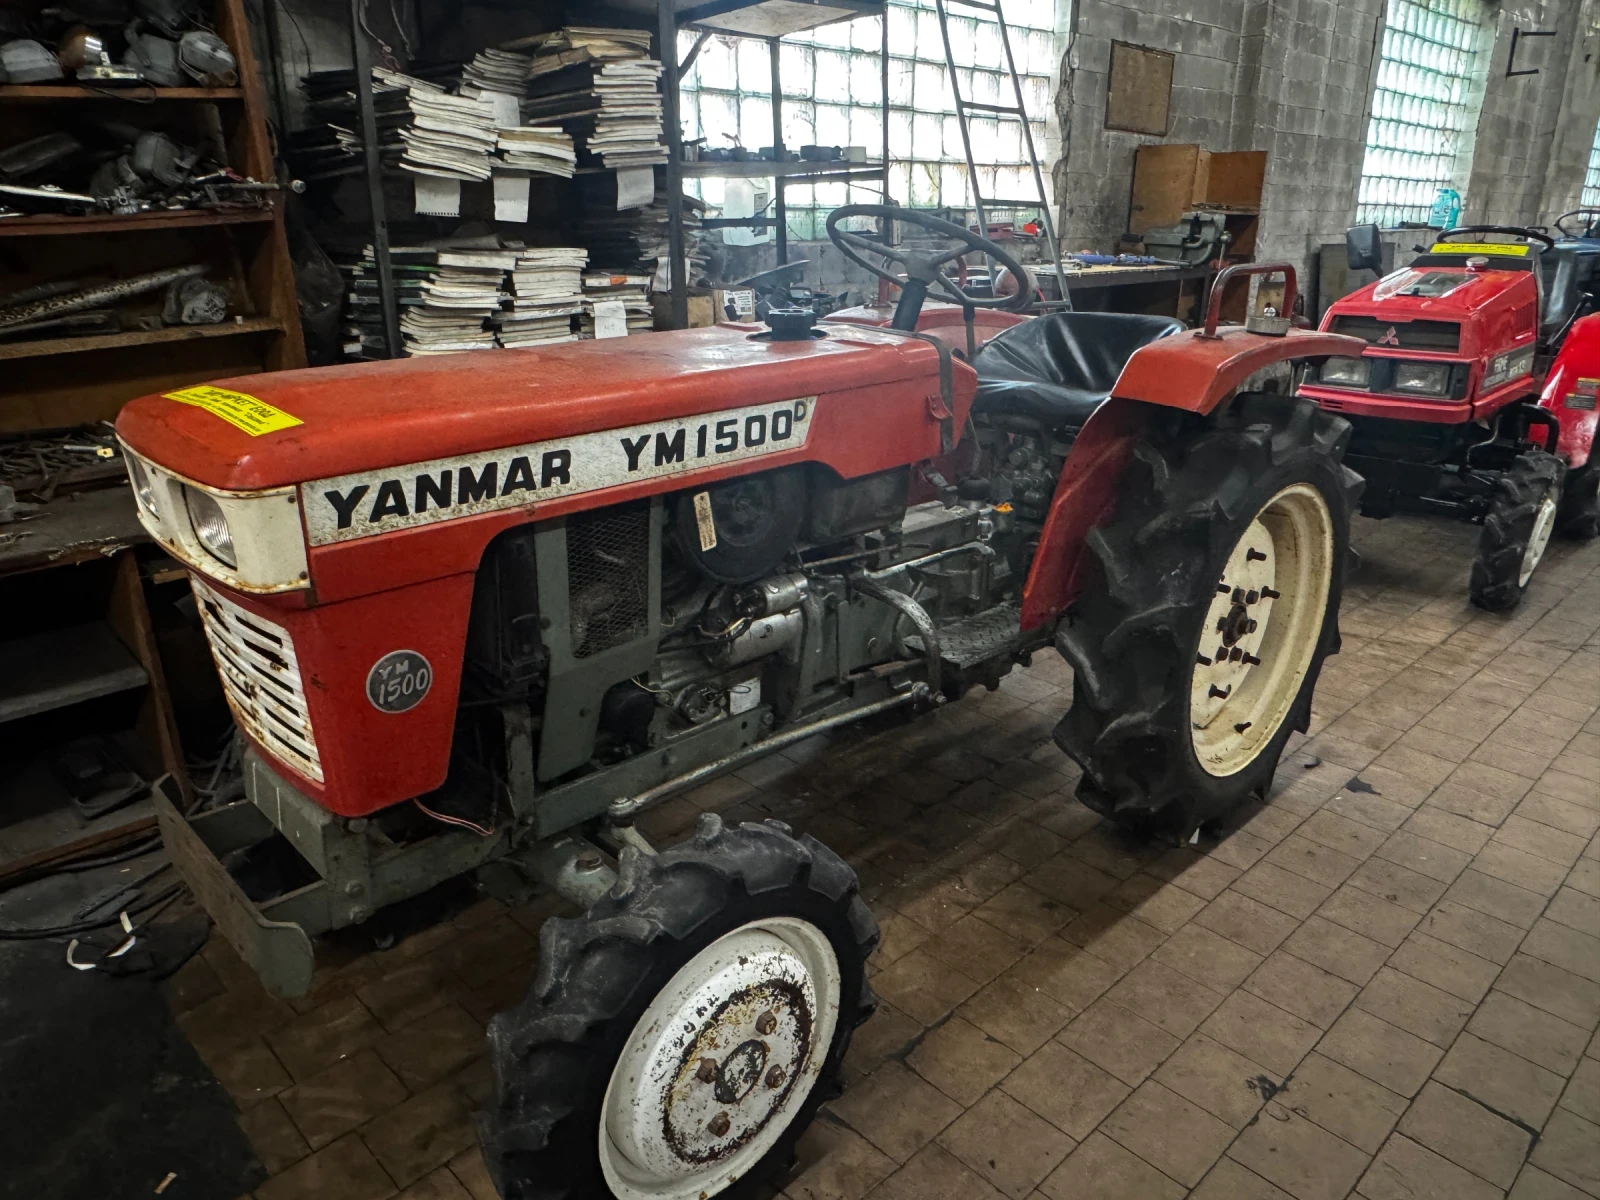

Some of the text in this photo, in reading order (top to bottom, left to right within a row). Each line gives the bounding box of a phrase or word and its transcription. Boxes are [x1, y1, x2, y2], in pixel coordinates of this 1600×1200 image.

[323, 448, 571, 530] YANMAR
[378, 659, 409, 680] YM
[378, 668, 429, 705] 1500
